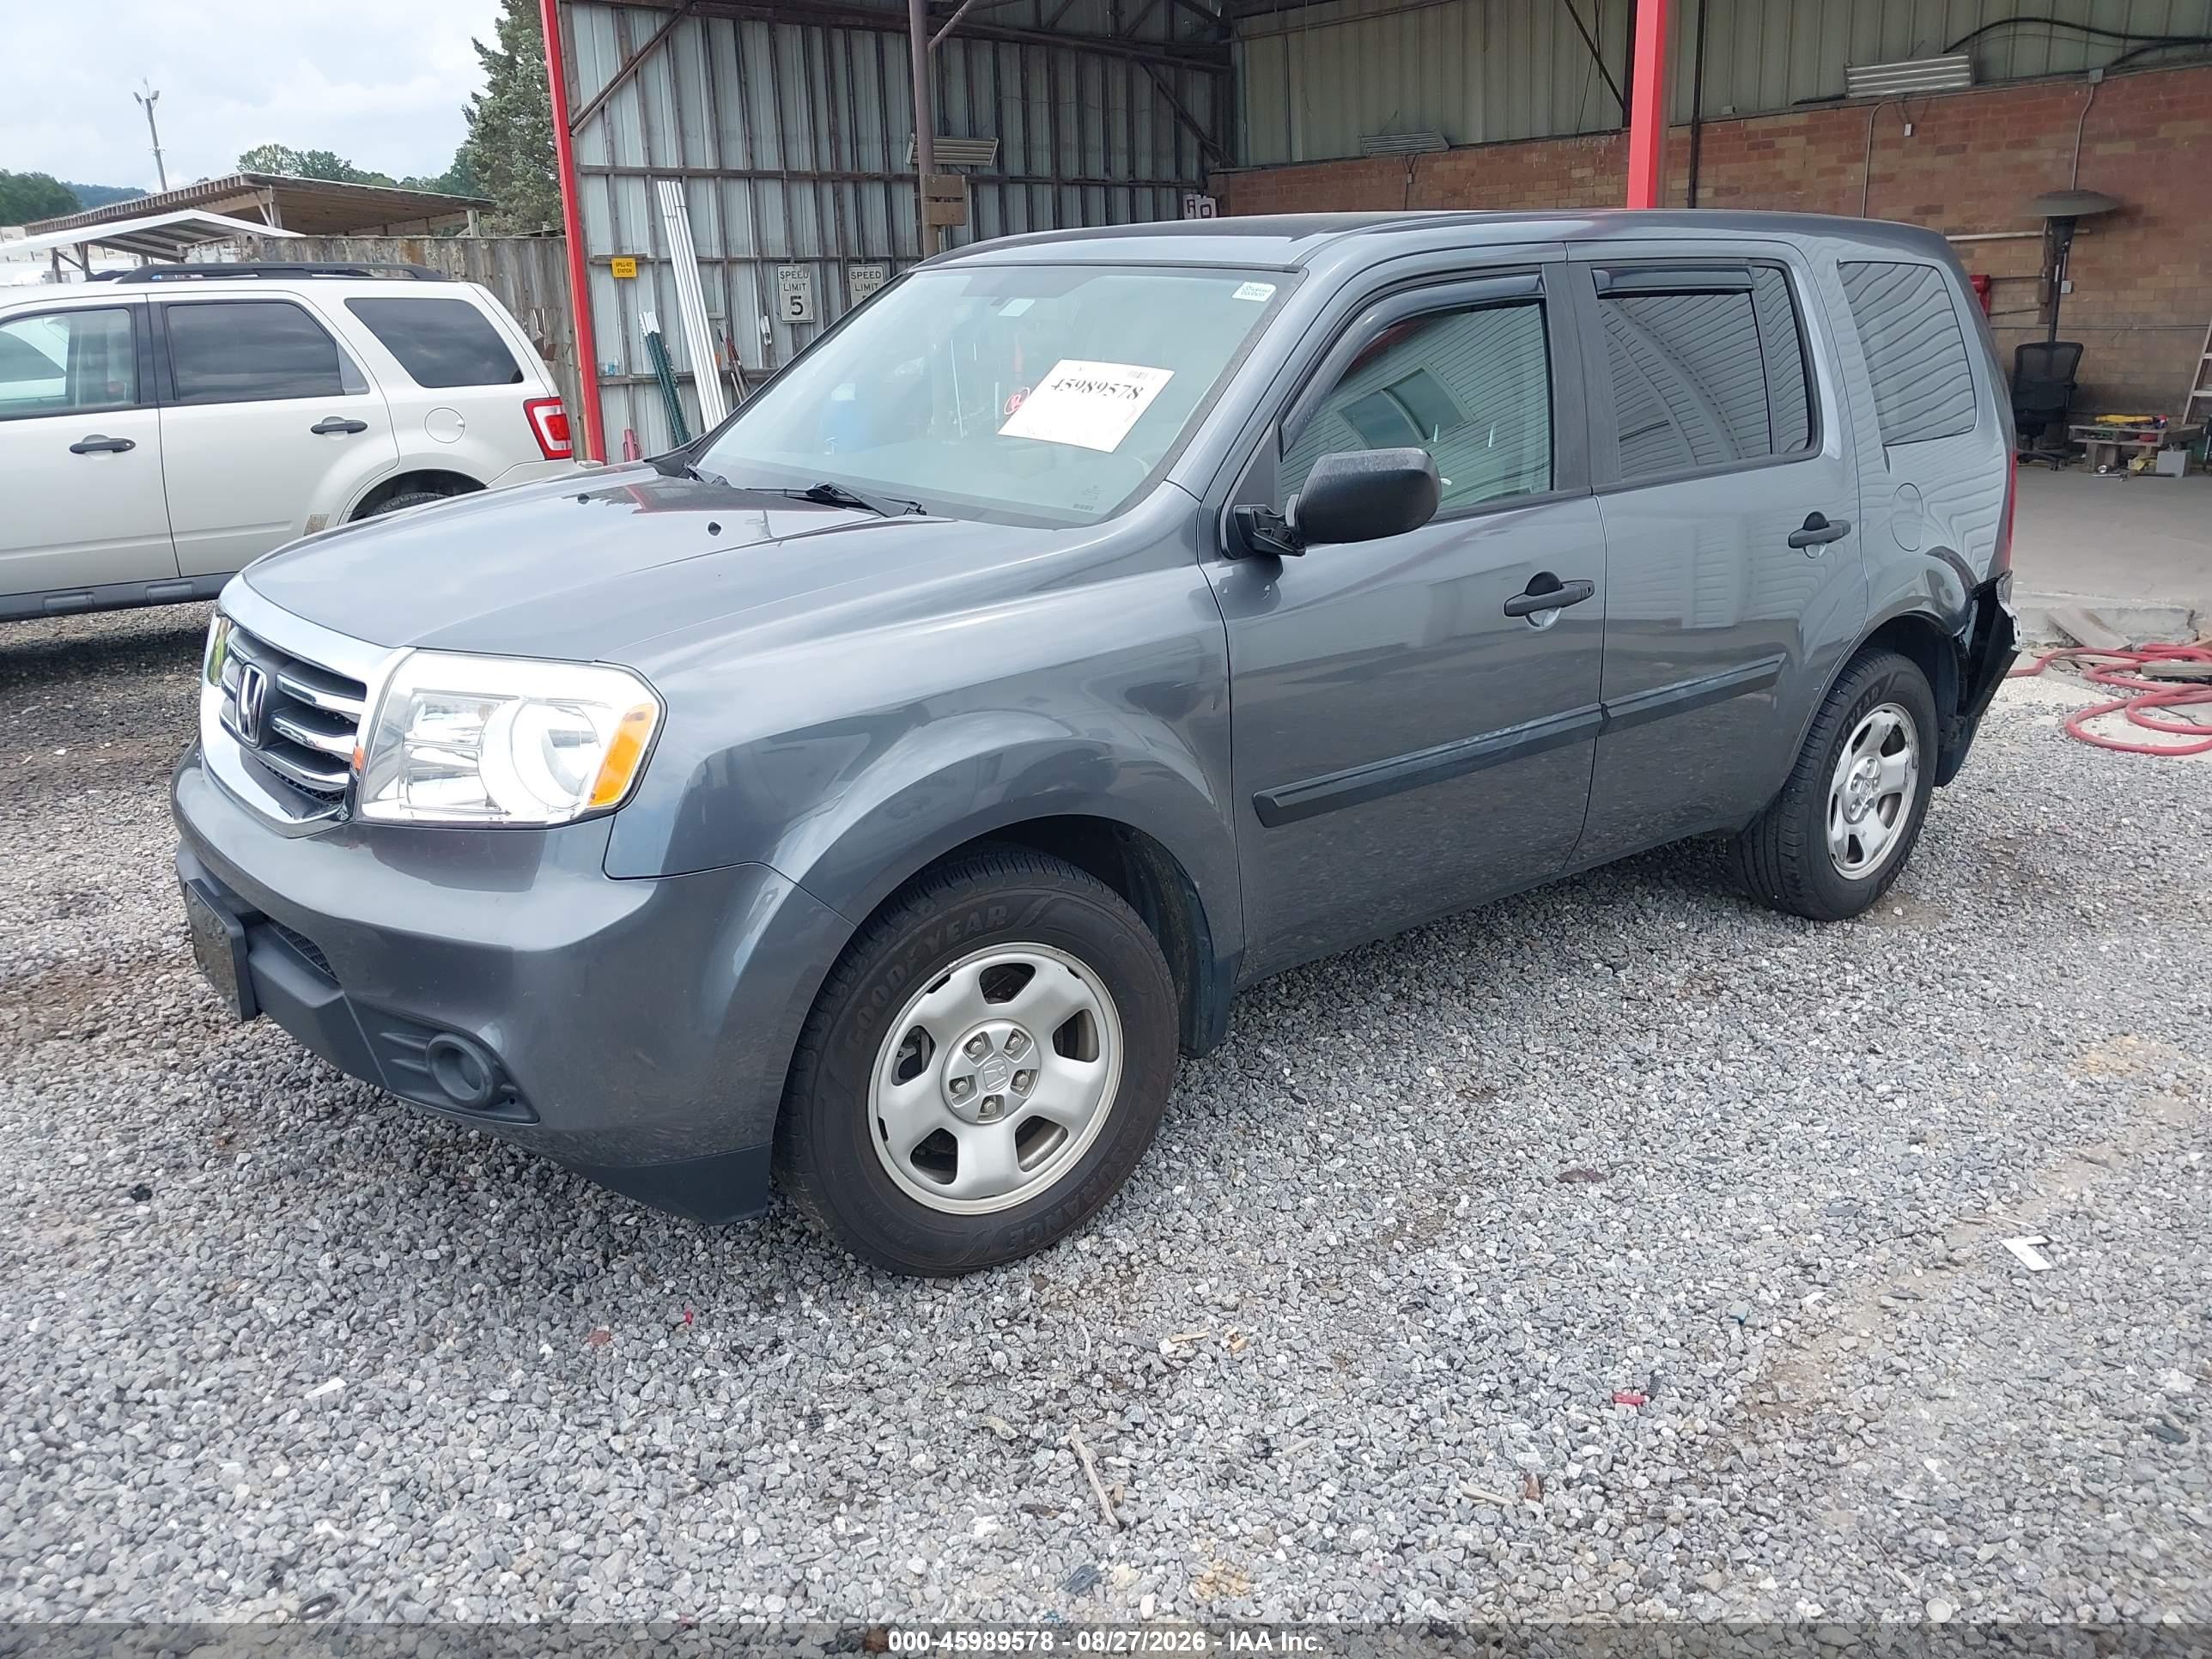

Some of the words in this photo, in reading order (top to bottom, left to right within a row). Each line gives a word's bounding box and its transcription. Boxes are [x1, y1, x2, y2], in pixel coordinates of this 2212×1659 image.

[780, 270, 811, 280] SPEED
[851, 270, 882, 280] SPEED
[783, 283, 807, 292] LIMIT
[854, 283, 878, 292] LIMIT
[790, 295, 804, 316] 5
[1050, 377, 1145, 401] 45989578
